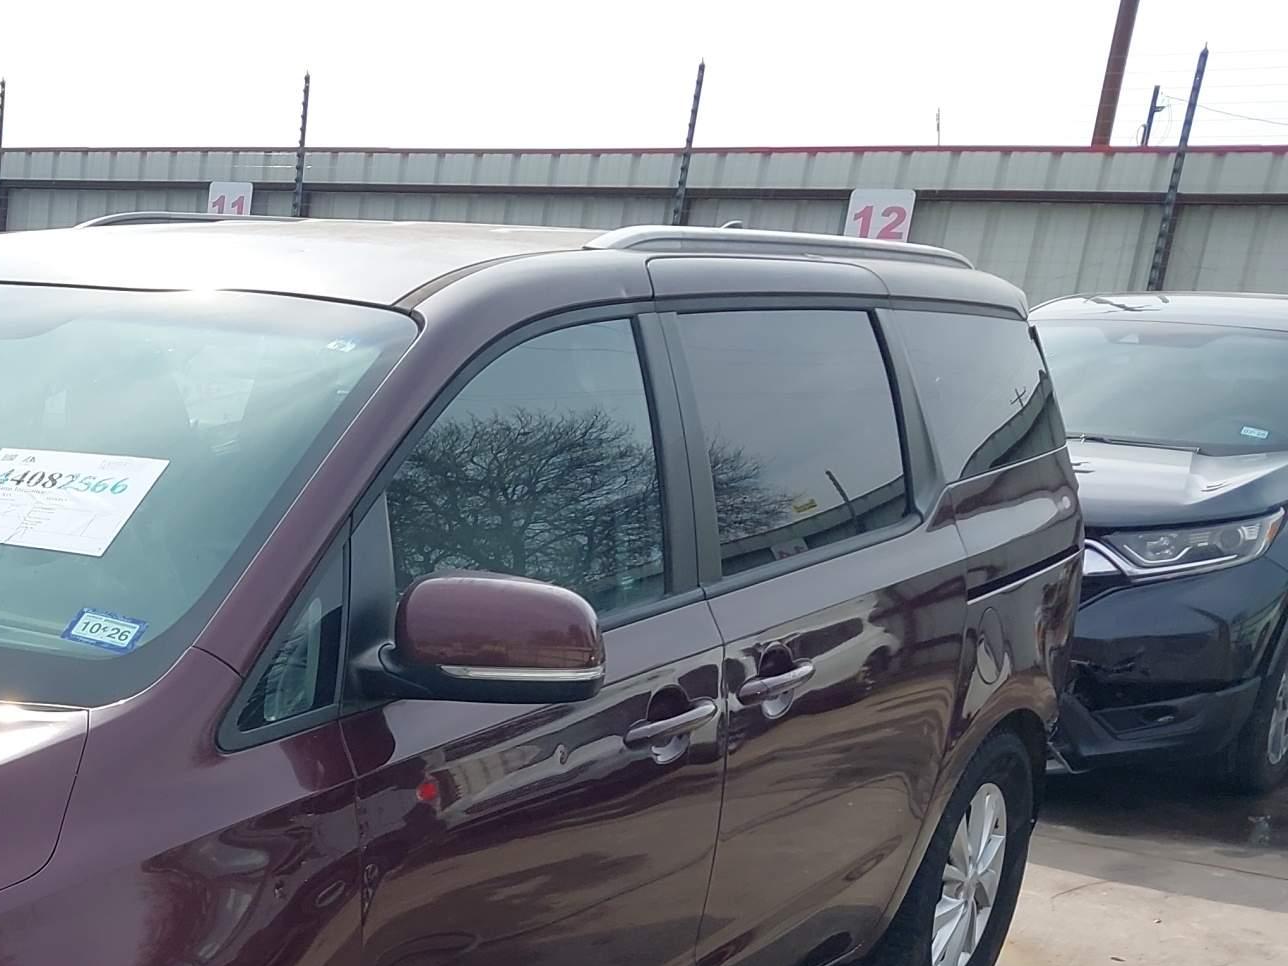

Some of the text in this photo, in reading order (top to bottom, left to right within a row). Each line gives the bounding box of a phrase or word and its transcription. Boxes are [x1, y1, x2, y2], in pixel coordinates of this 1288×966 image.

[212, 194, 245, 216] 11
[853, 204, 907, 240] 12
[80, 620, 132, 642] 10 26
